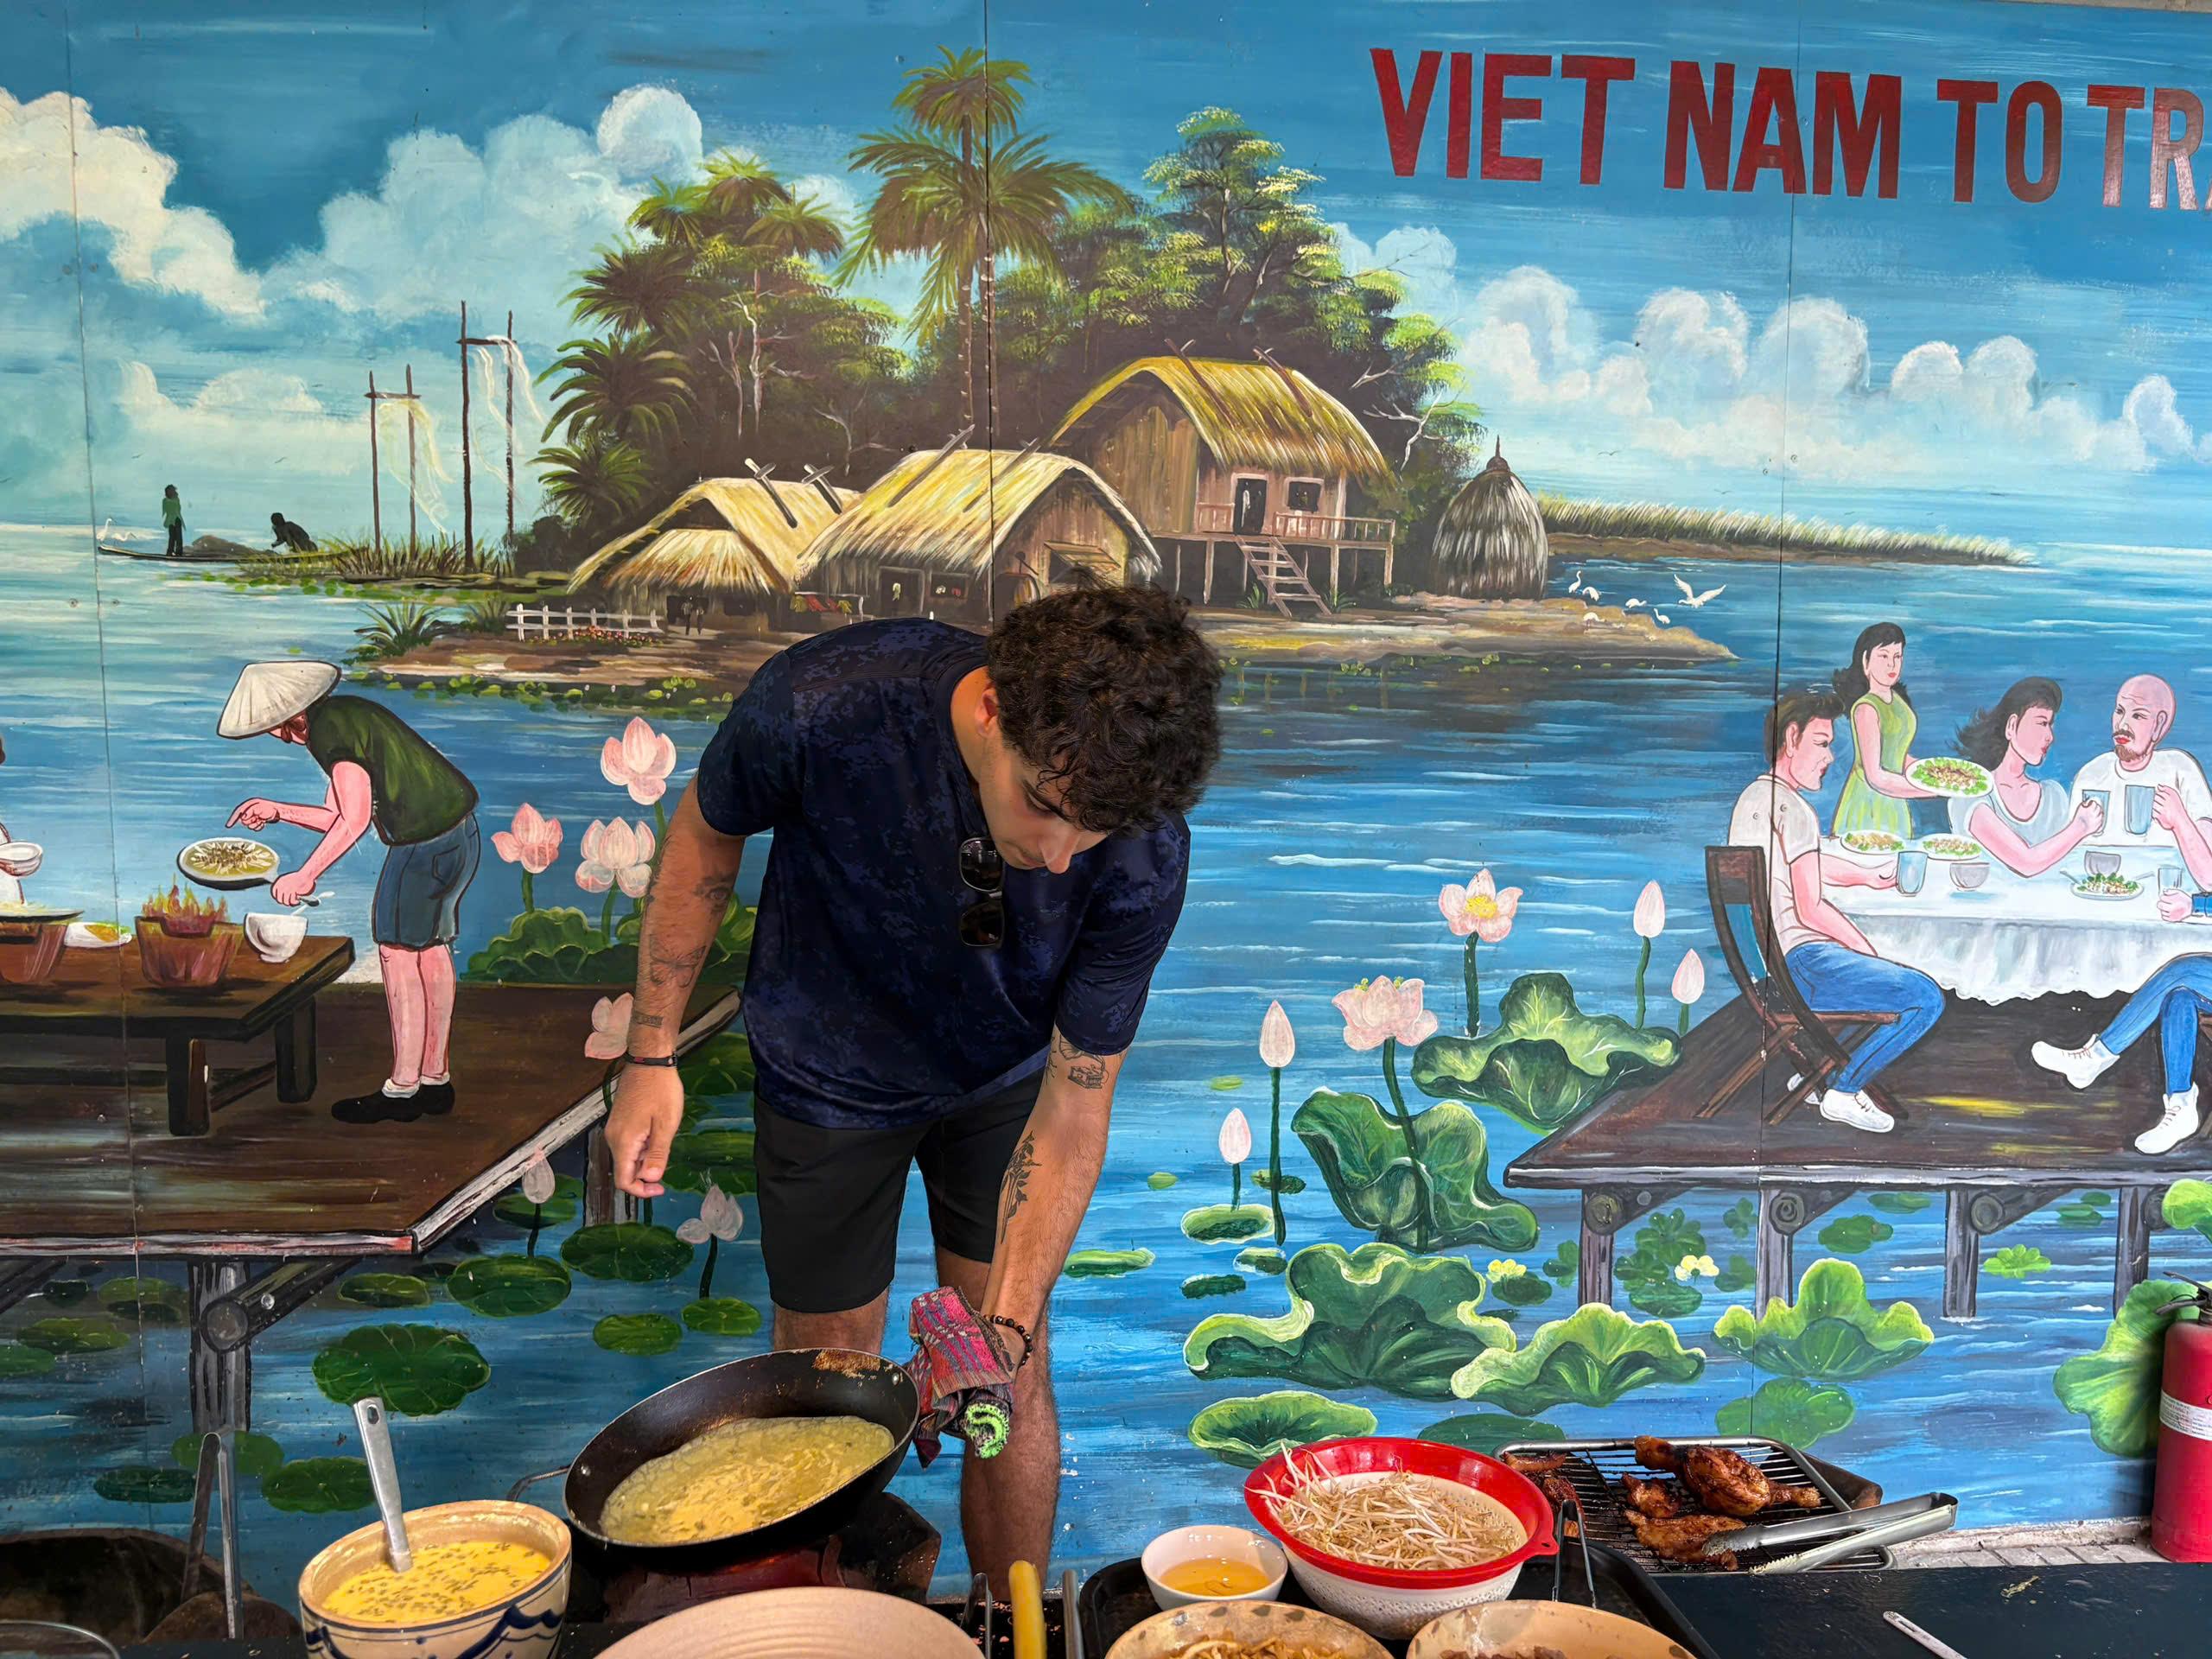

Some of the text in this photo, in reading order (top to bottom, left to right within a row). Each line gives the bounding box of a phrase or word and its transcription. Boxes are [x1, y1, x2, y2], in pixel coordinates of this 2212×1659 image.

[1370, 48, 2212, 211] VIET NAM TO TR
